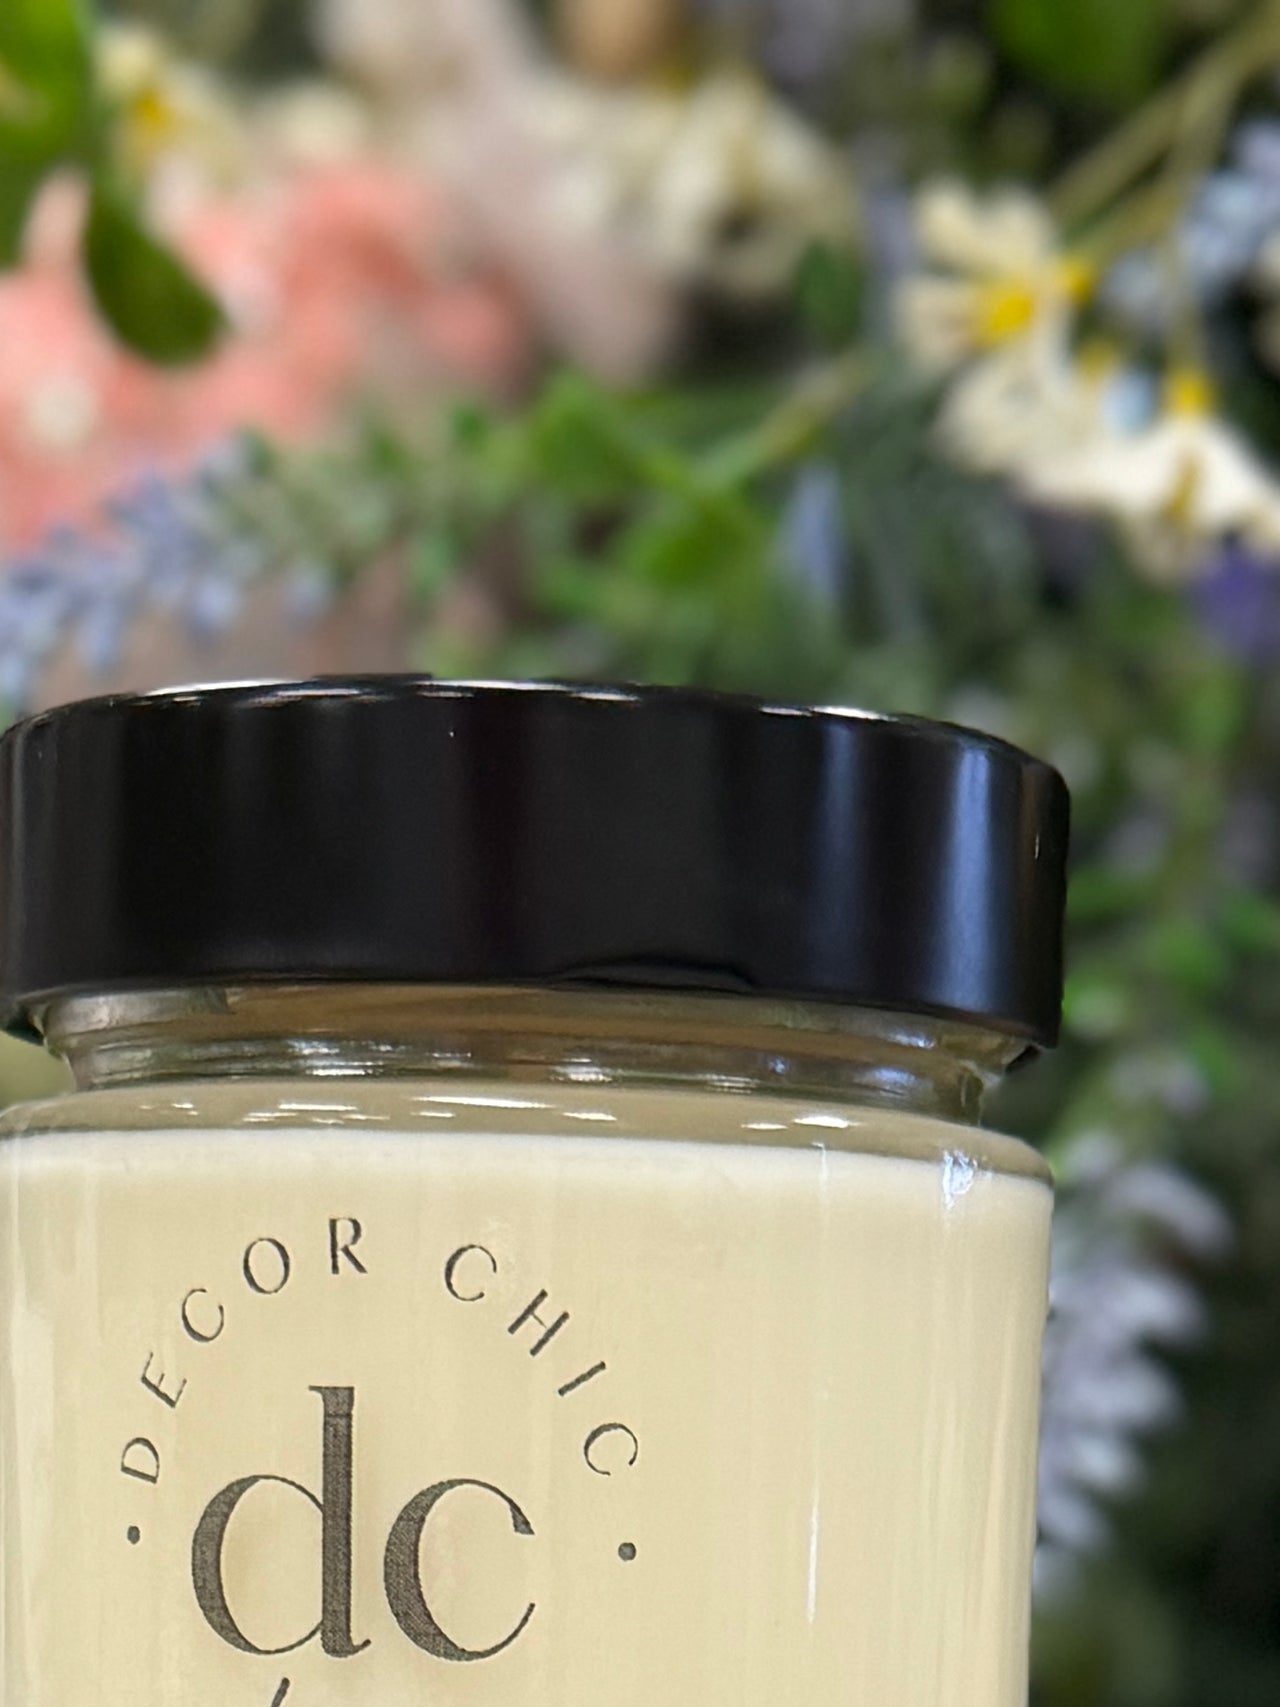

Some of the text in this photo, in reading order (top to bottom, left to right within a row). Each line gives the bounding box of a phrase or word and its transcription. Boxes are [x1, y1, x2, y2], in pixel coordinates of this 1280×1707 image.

[120, 1216, 639, 1485] DECOR CHIC
[190, 1384, 536, 1663] dc
